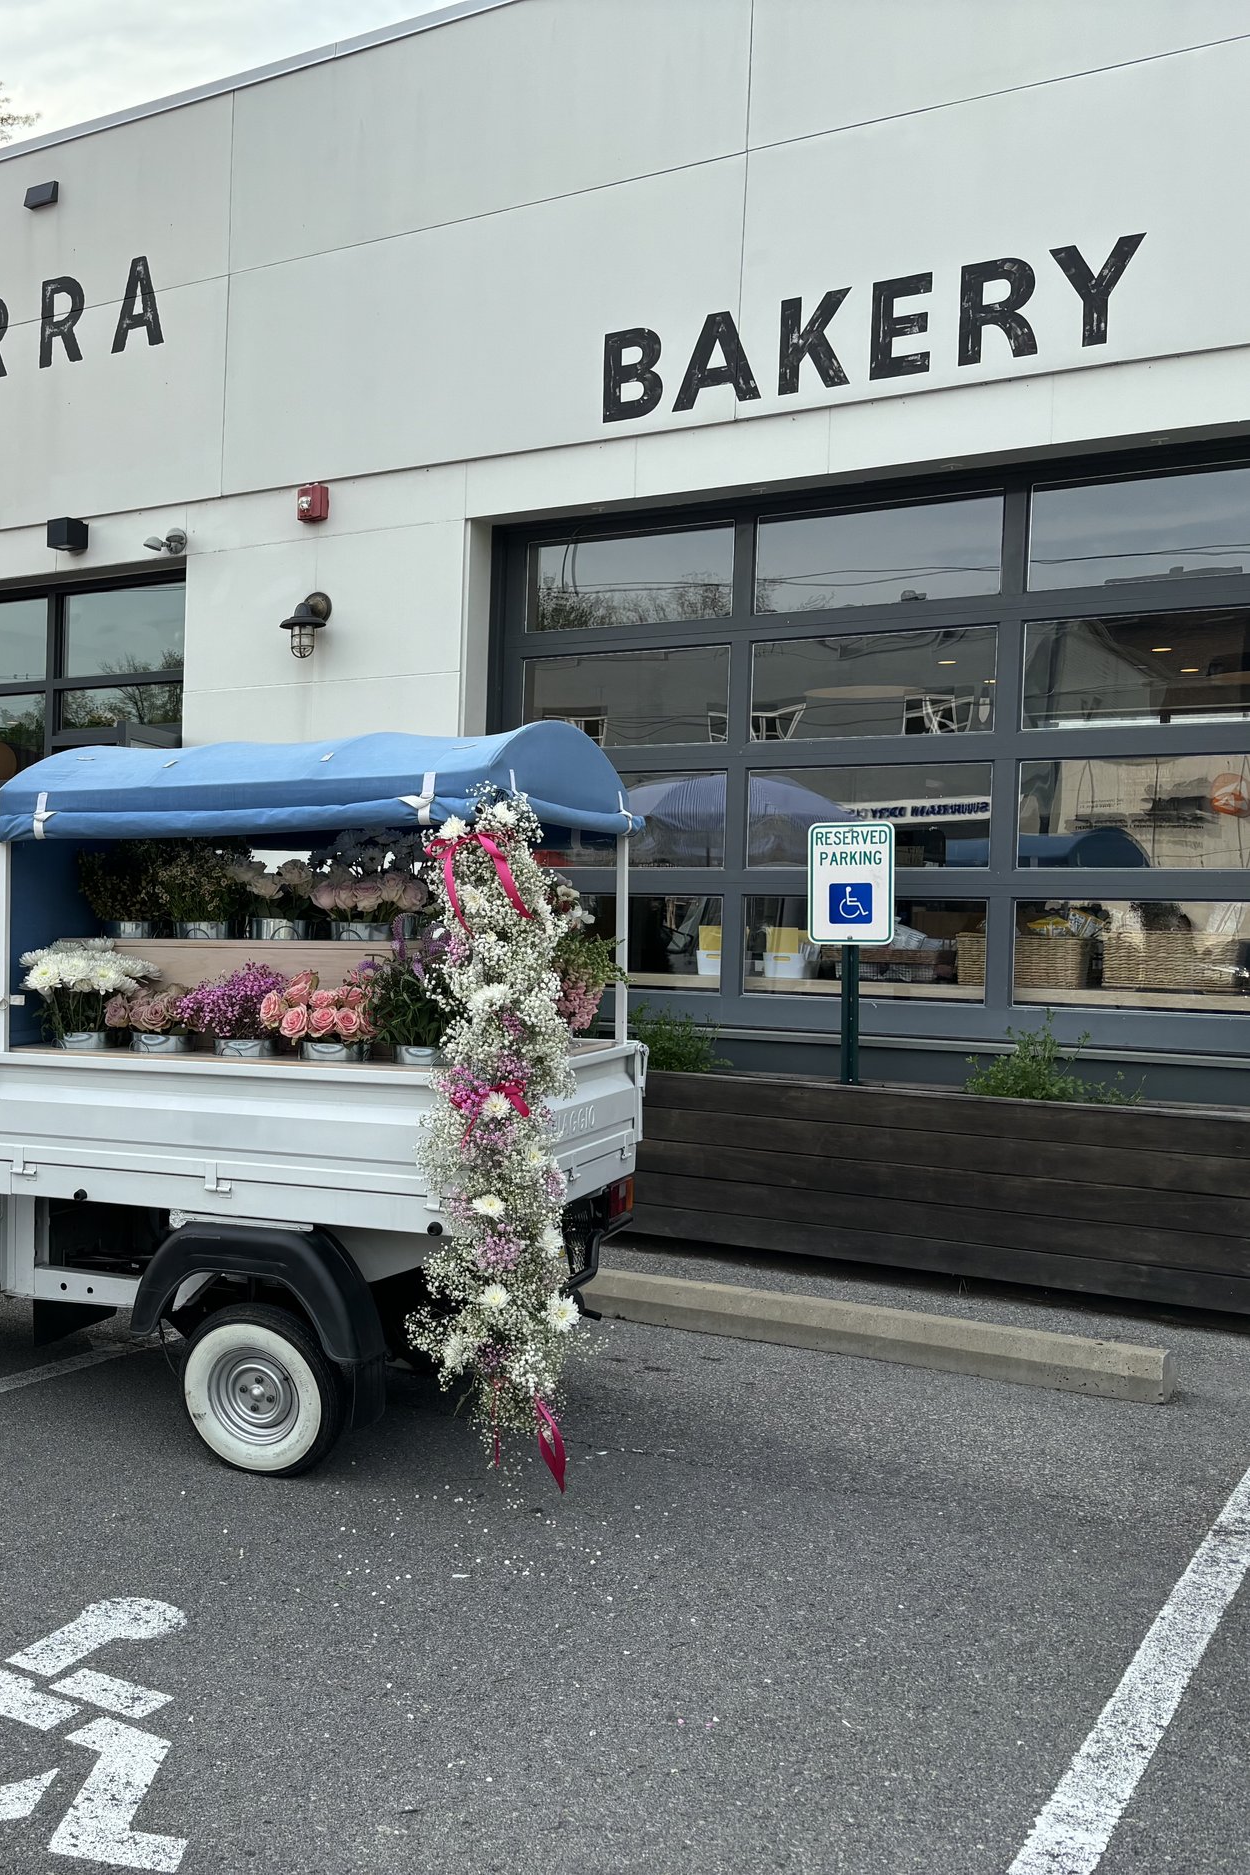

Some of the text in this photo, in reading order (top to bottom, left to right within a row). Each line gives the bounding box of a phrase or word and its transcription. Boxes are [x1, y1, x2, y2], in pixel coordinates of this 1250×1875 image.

[602, 231, 1147, 424] BAKERY
[815, 829, 888, 846] RESERVED
[819, 850, 882, 866] PARKING
[556, 1104, 595, 1134] IAGGIO
